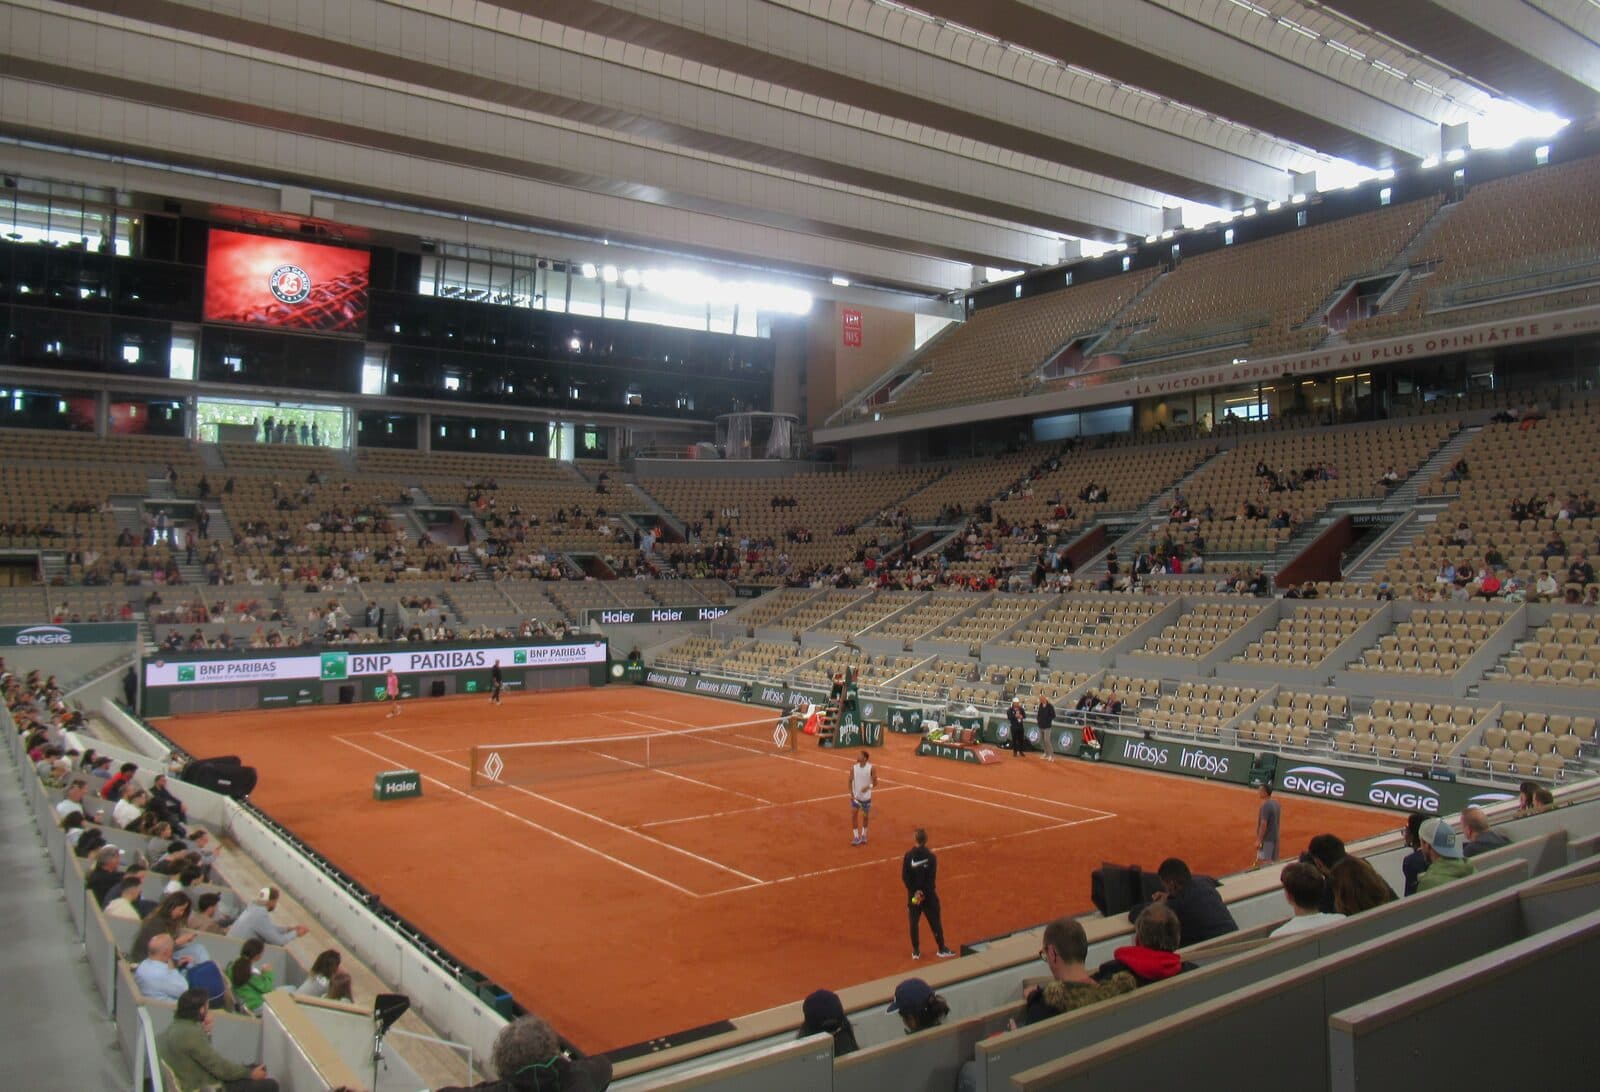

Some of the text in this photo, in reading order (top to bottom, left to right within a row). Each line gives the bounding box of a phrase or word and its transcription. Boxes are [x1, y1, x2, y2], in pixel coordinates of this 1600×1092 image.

[1137, 384, 1150, 395] LA
[1157, 373, 1224, 391] VICTOIRE
[1232, 356, 1330, 380] APPARTIENT
[1340, 352, 1361, 364] AU
[1371, 343, 1415, 359] PLUS
[1425, 323, 1539, 351] OPINIÂTRE
[602, 611, 634, 623] Haier
[652, 609, 683, 622] Haier
[530, 649, 549, 659] BNP
[550, 647, 587, 657] PARIBAS
[200, 661, 277, 675] BNP PARIBAS
[353, 651, 485, 673] BNP PARIBAS
[1123, 740, 1168, 766] Infosys
[1180, 747, 1229, 775] Infosys
[386, 781, 416, 793] Haier
